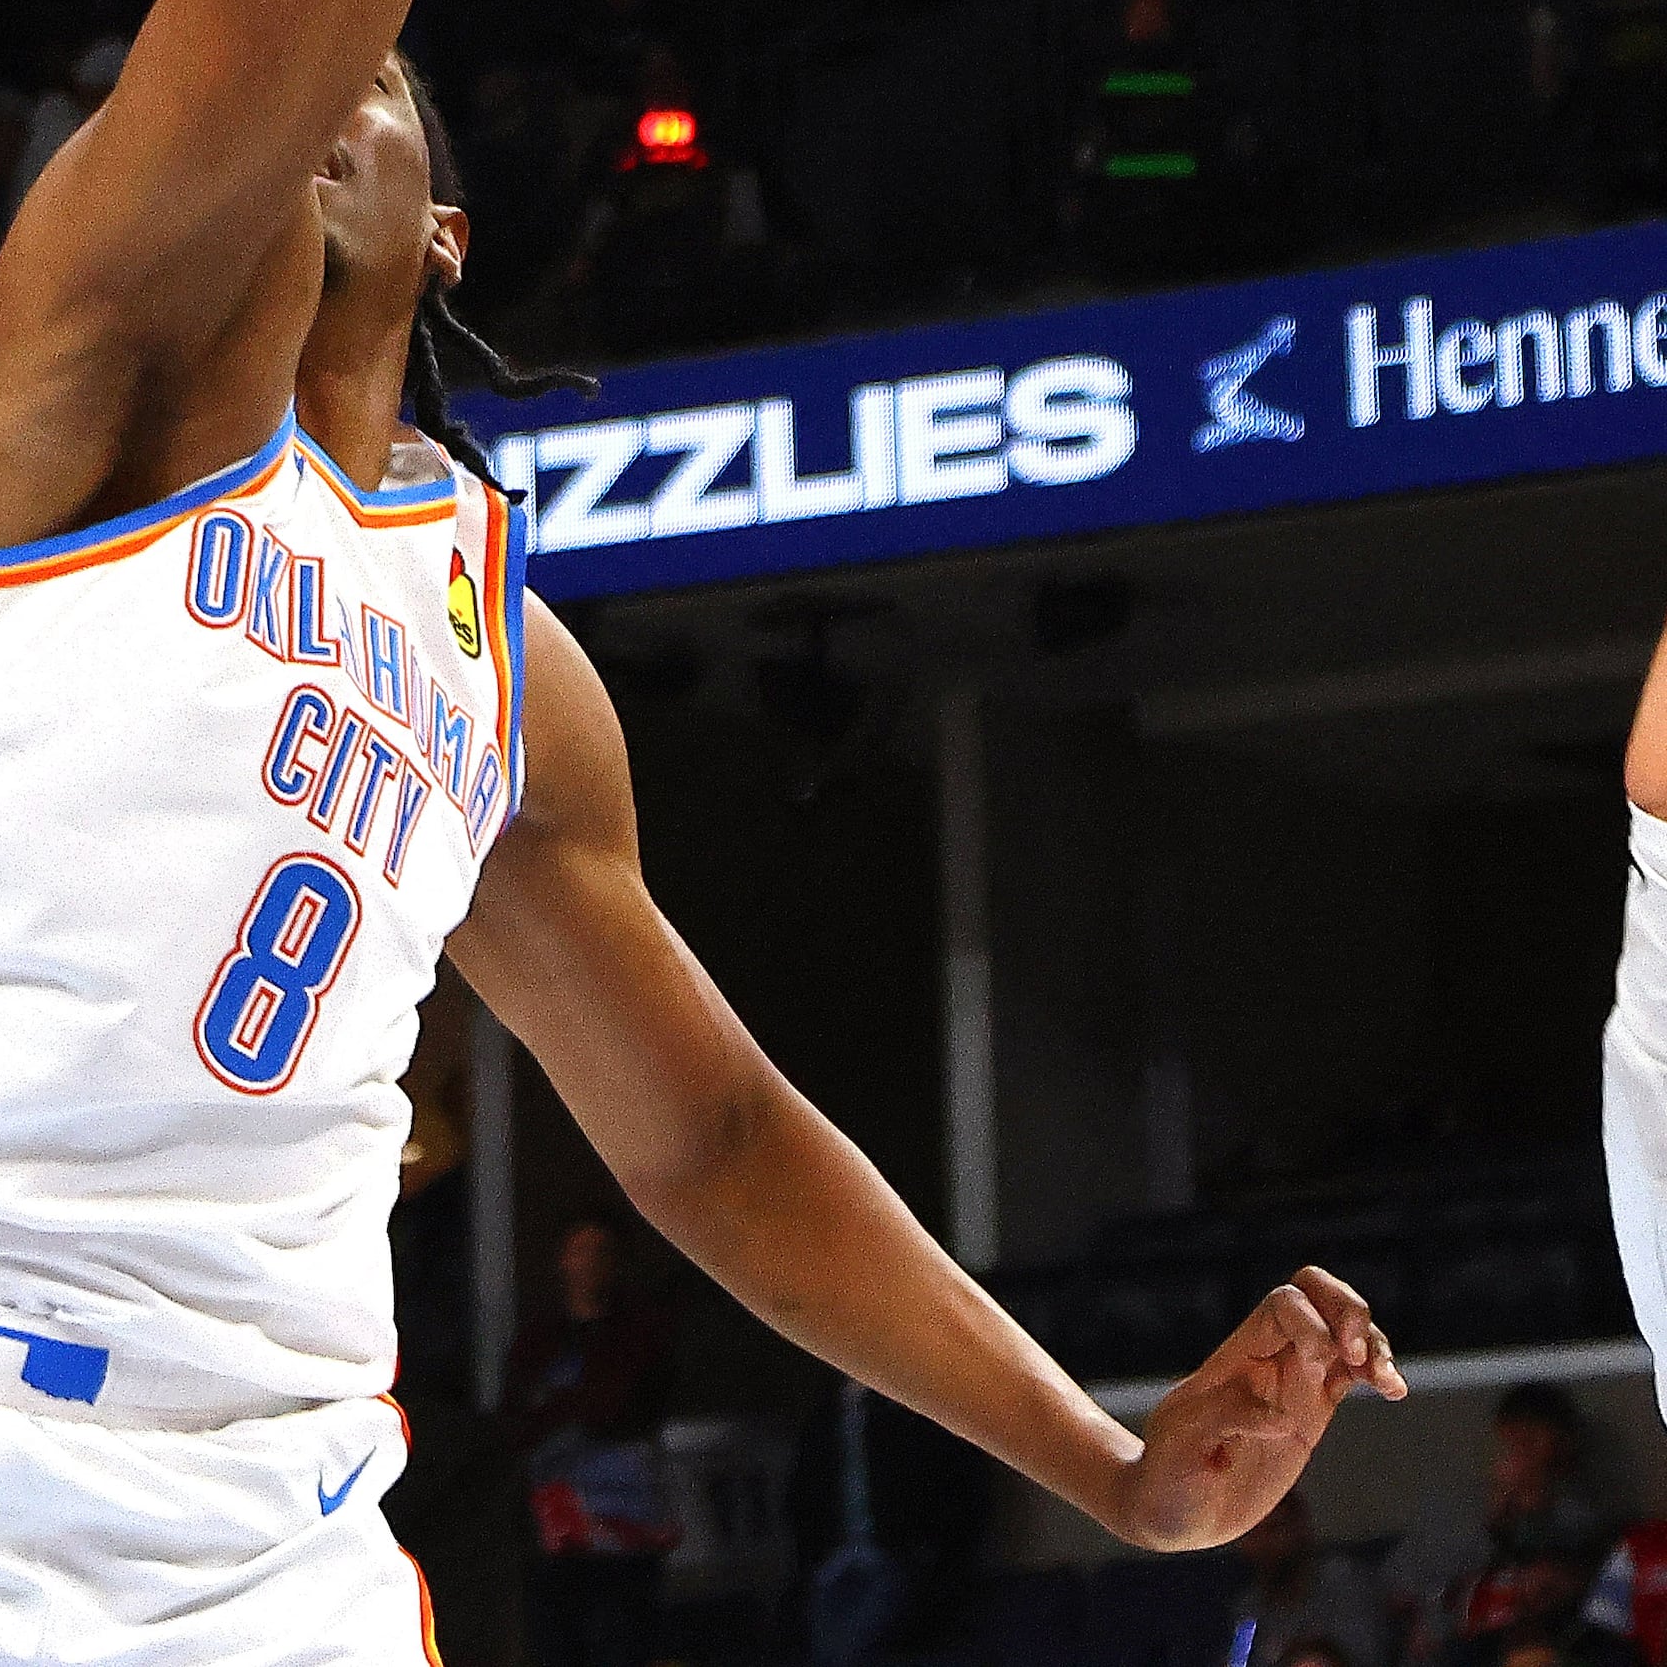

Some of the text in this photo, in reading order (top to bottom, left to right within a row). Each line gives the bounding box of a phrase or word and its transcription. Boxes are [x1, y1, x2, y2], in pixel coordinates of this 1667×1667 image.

[183, 507, 509, 860] OKLHMA
[261, 683, 433, 890] CITY
[192, 850, 364, 1097] 8
